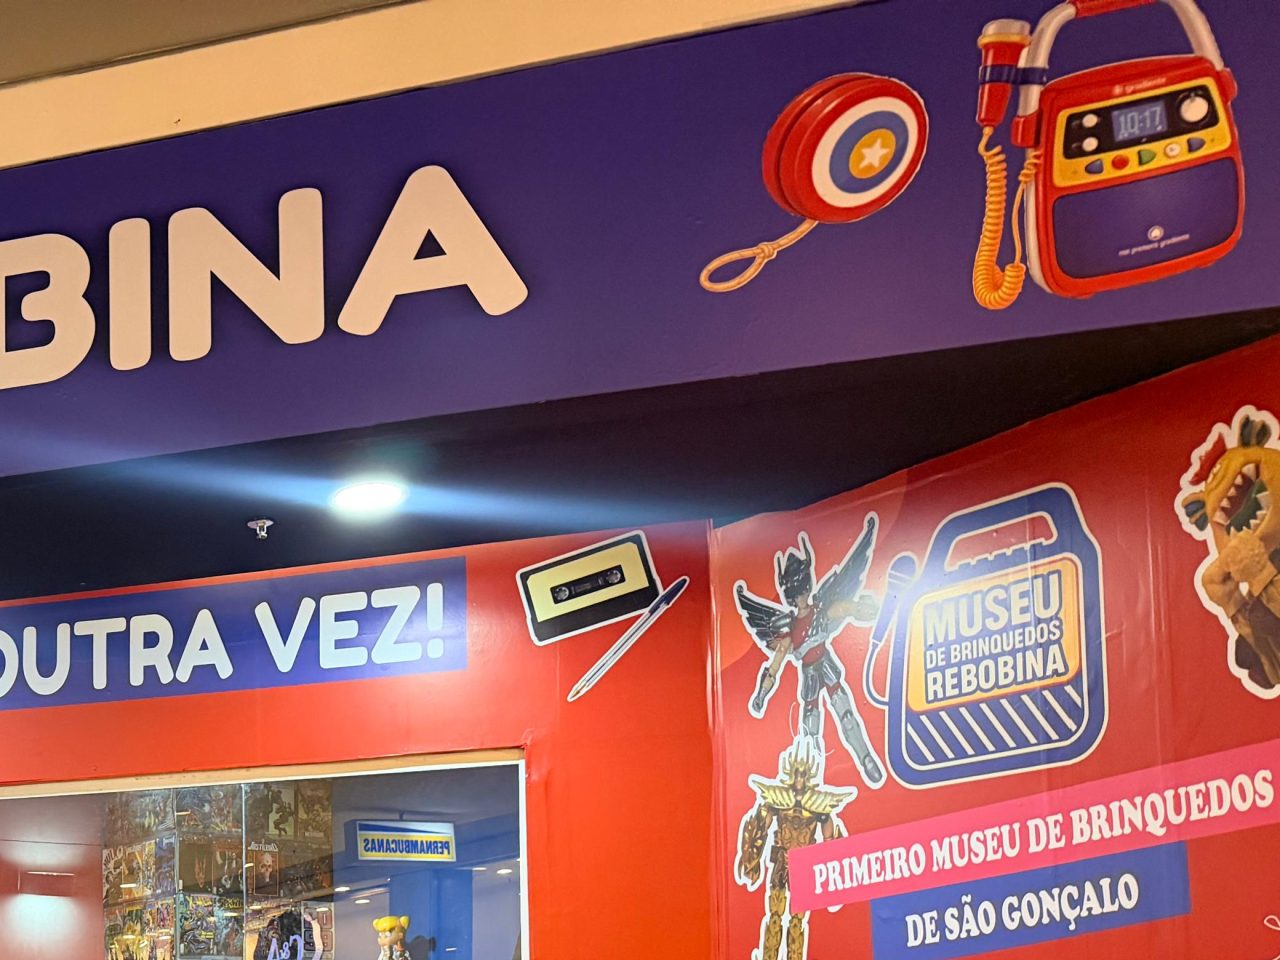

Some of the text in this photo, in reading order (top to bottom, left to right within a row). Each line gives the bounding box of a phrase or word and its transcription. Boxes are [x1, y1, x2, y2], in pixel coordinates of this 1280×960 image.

[254, 582, 444, 674] VEZ!
[926, 620, 1061, 669] DE BRINQUEDOS
[927, 574, 1060, 646] MUSEU
[927, 644, 1066, 701] REBOBINA
[813, 769, 1275, 894] PRIMEIRO MUSEU DE BRINQUEDOS
[905, 873, 1140, 948] DE SÃO GONÇALO
